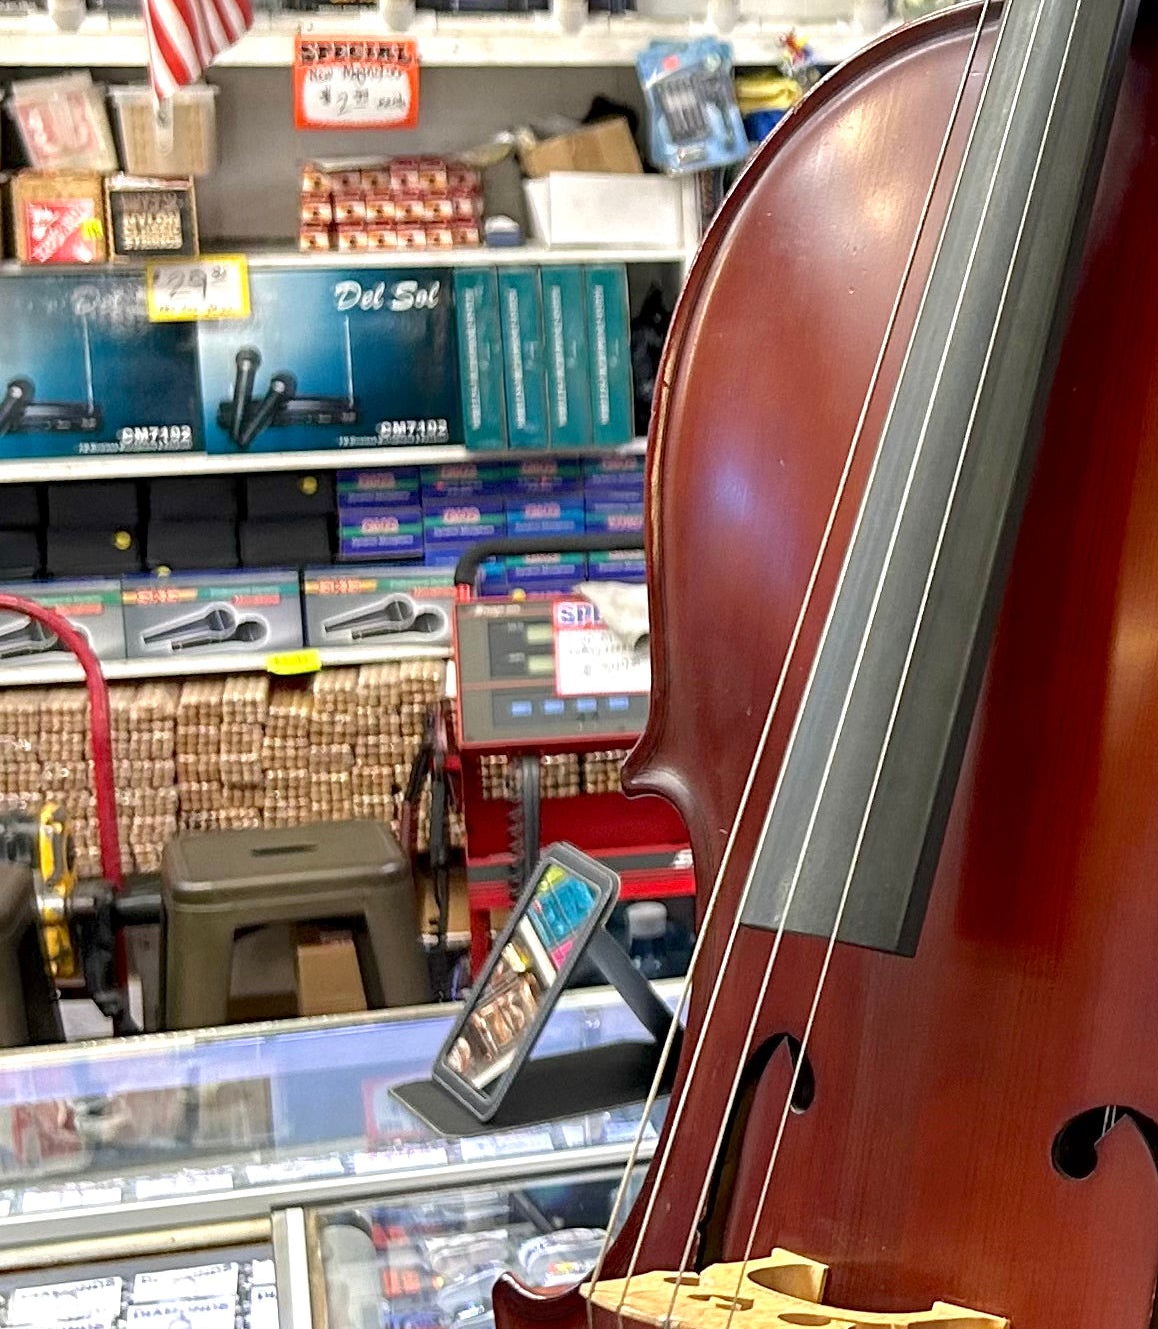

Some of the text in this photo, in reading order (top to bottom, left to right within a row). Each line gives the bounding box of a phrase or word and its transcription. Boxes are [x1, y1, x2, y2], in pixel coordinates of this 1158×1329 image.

[301, 41, 412, 64] SPECIAL
[334, 279, 441, 312] Del Sol
